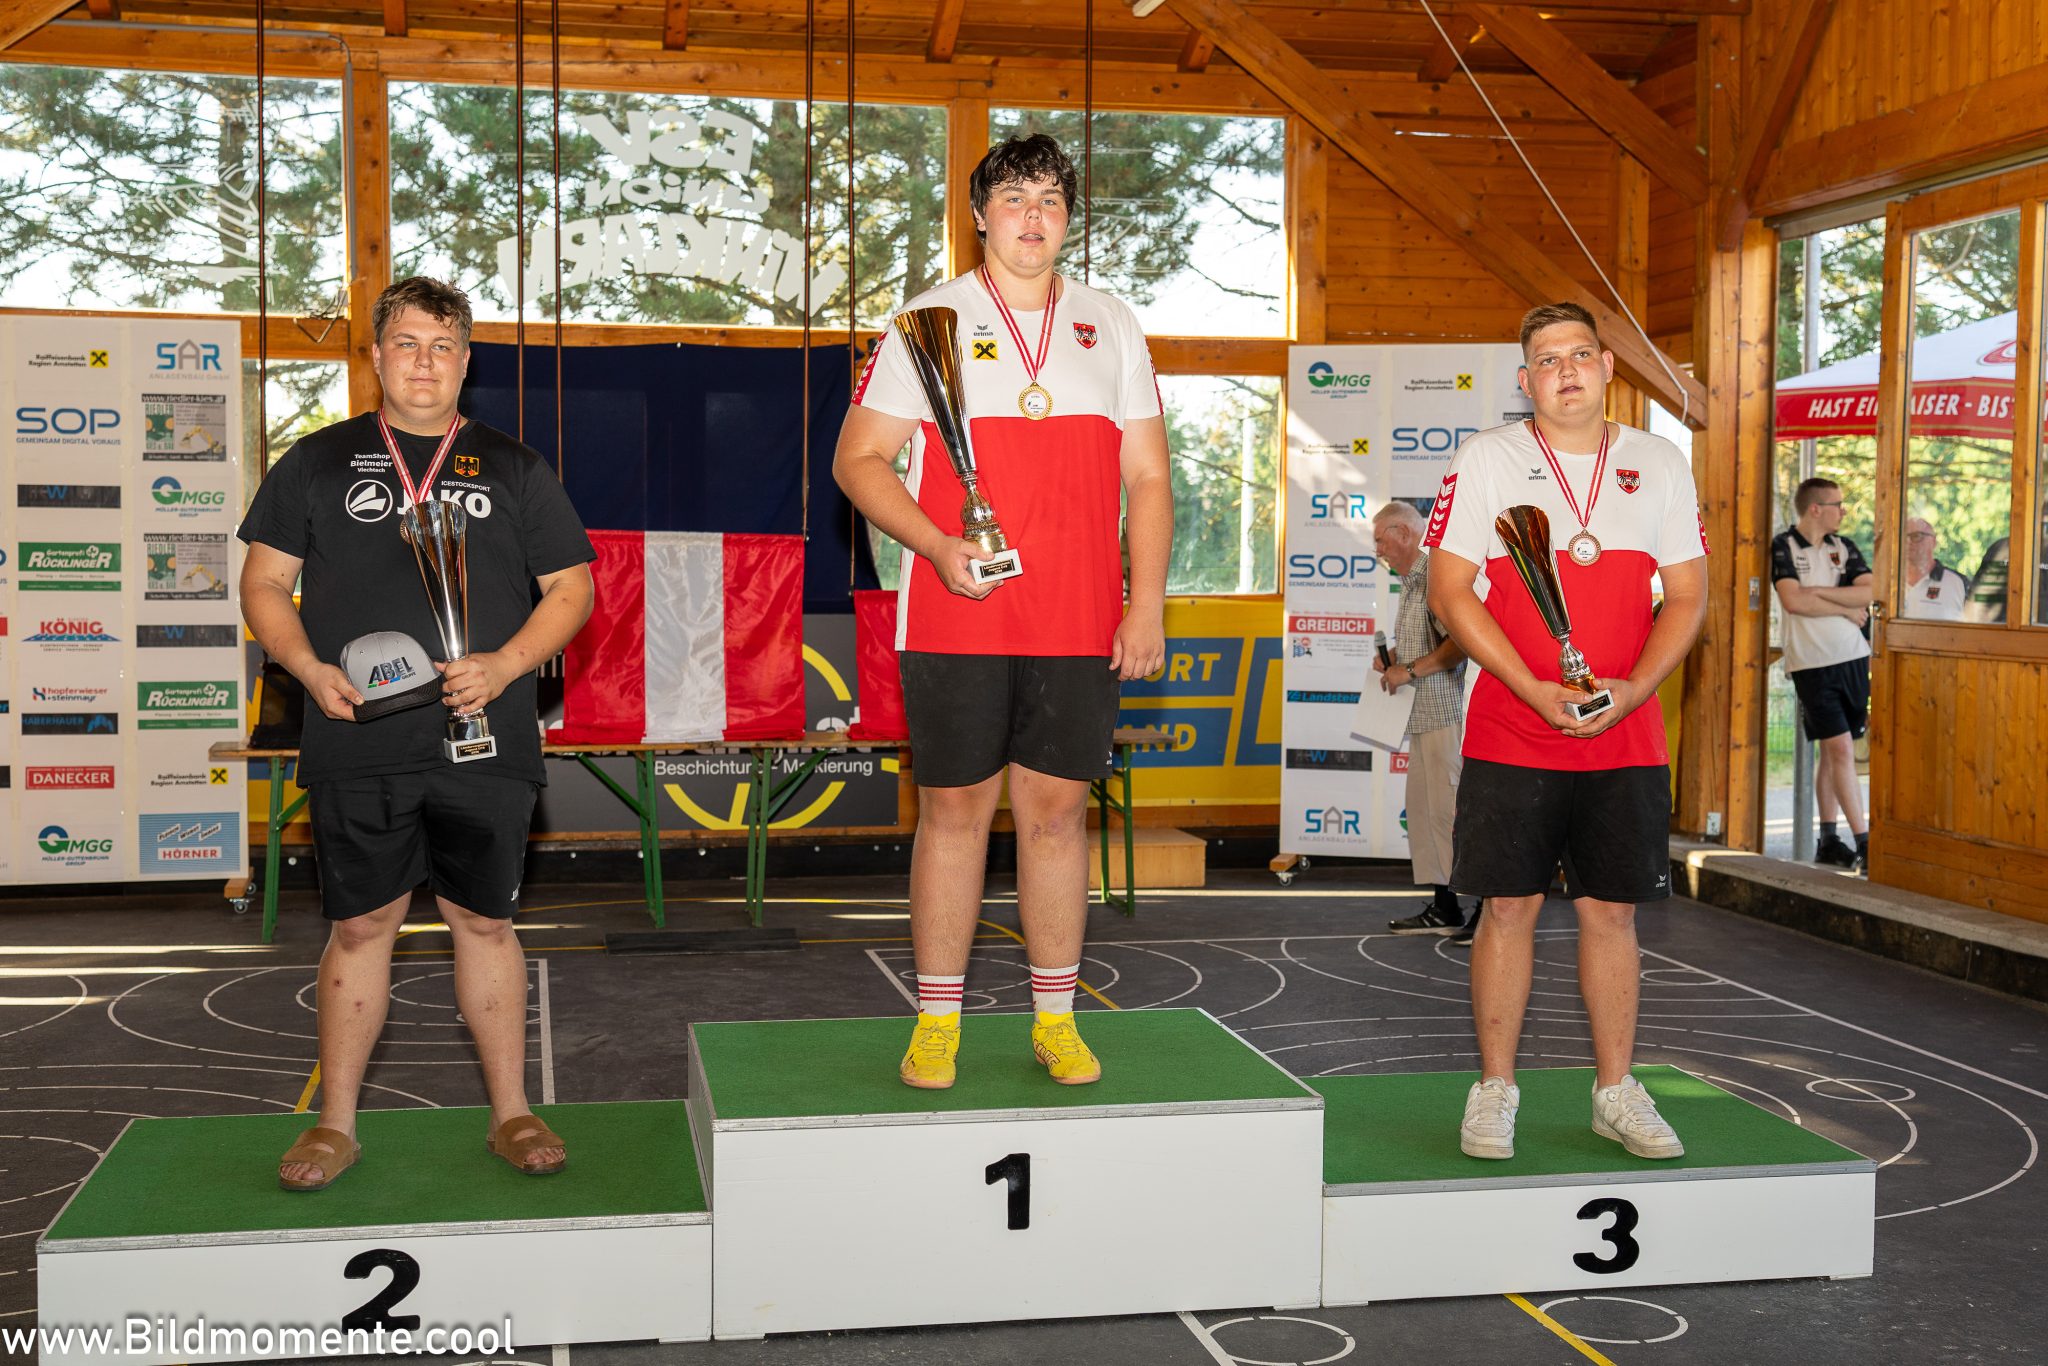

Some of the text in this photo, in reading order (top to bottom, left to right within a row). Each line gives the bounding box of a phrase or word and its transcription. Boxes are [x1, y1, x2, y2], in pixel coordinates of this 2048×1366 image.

[156, 339, 222, 371] SAR
[1334, 374, 1372, 388] MGG
[1807, 397, 1855, 419] HAST
[16, 407, 121, 435] SOP
[441, 480, 491, 492] ICESTOCKSPORT
[182, 491, 225, 505] MGG
[1311, 491, 1366, 519] SAR
[28, 551, 112, 568] RÜCKLINGER
[1289, 554, 1377, 579] SOP
[40, 618, 103, 634] KÖNIG
[1296, 618, 1367, 632] GREIBICH
[369, 656, 414, 684] ABEL
[146, 690, 229, 707] RÜCKLINGER
[33, 772, 110, 784] DANECKER
[1304, 806, 1361, 835] SAR
[69, 839, 113, 854] MGG
[162, 848, 218, 860] HÖRNER
[985, 1153, 1031, 1230] 1
[1573, 1197, 1640, 1274] 3
[341, 1248, 421, 1336] 2
